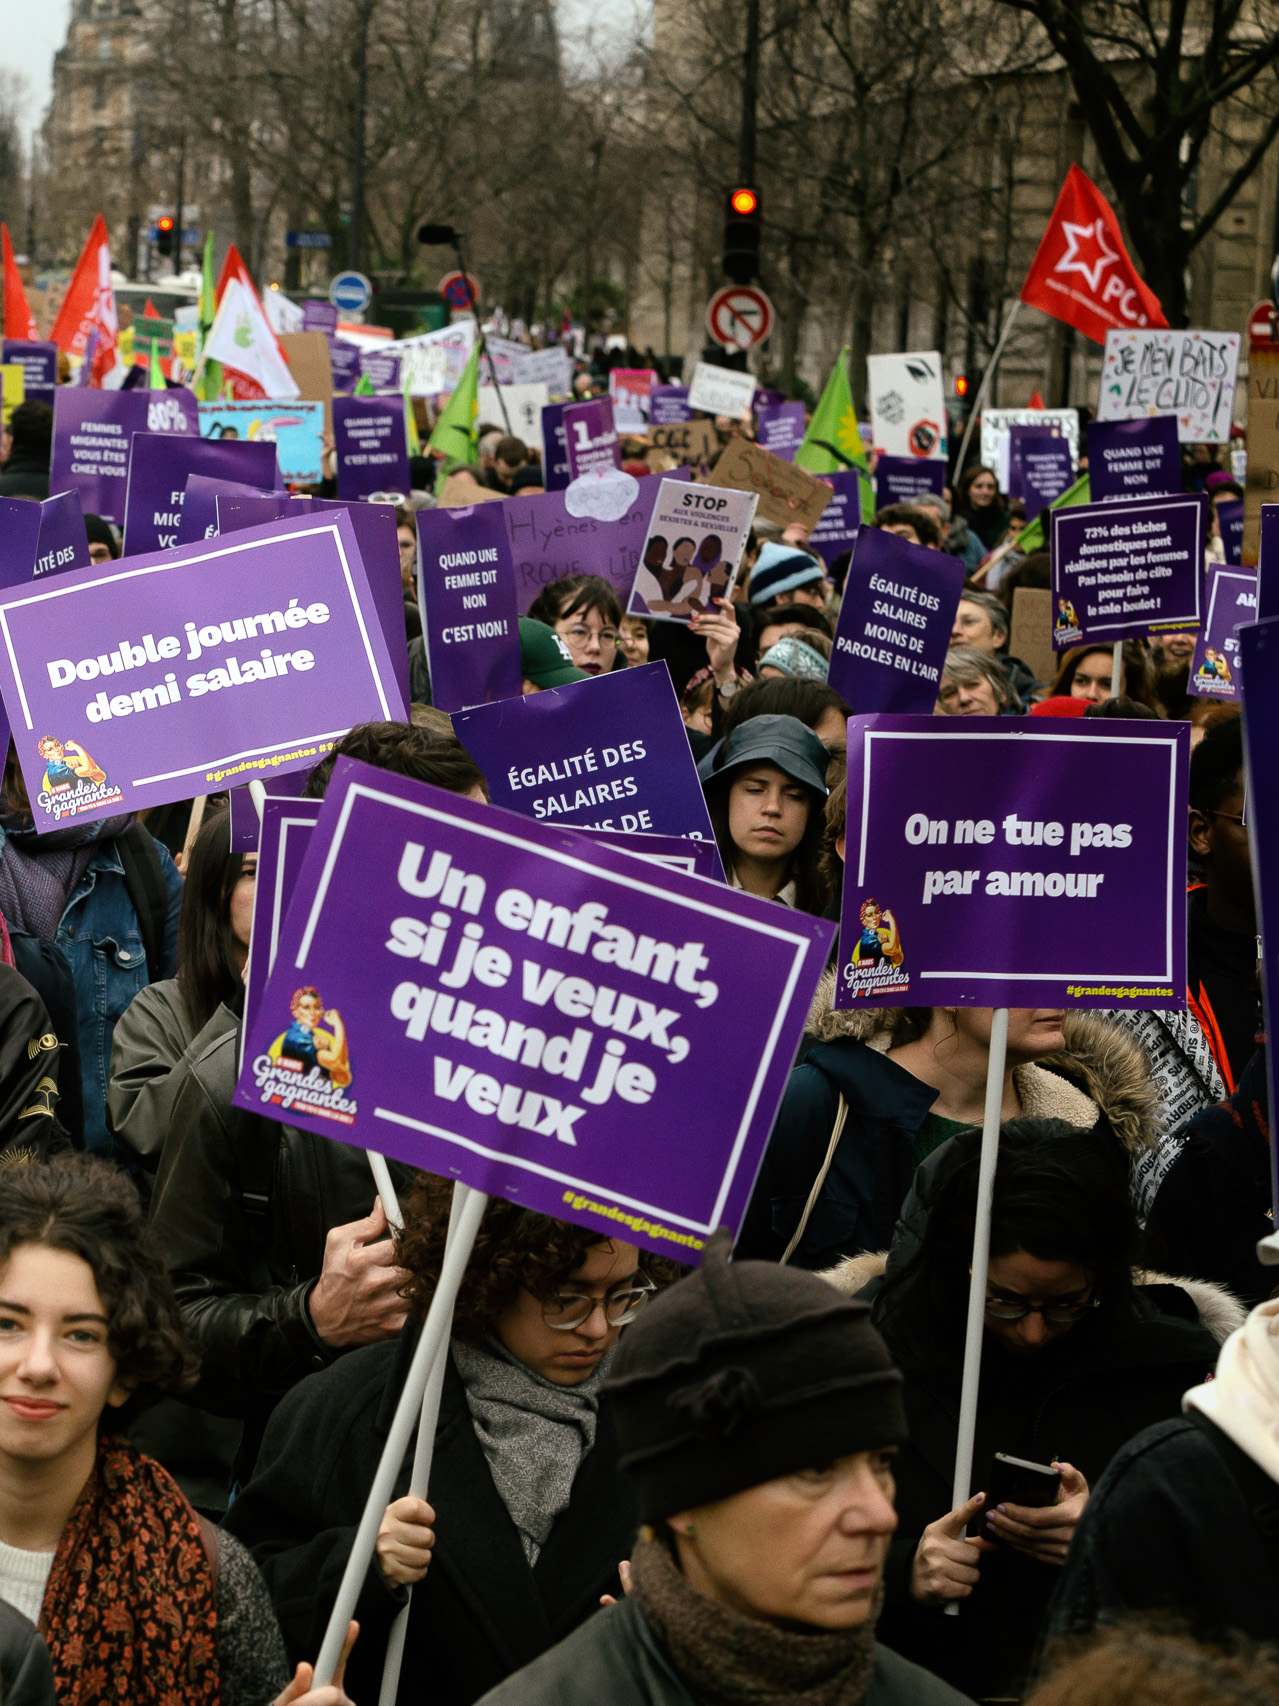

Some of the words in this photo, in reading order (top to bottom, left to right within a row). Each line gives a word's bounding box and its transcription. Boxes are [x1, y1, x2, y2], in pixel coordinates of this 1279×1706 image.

[1114, 345, 1137, 377] JE
[1179, 338, 1228, 379] BATS
[1125, 374, 1151, 408] LE
[81, 422, 123, 436] FEMMES
[148, 400, 187, 431] 80%
[70, 435, 129, 450] MIGRANTES
[73, 449, 102, 462] VOUS
[1103, 447, 1143, 461] QUAND
[1142, 444, 1165, 456] UNE
[70, 463, 98, 475] CHEZ
[98, 465, 127, 478] VOUS
[1107, 460, 1145, 473] FEMME
[1123, 473, 1149, 485] NON
[682, 493, 728, 512] STOP
[689, 509, 730, 523] VIOLENCES
[509, 509, 598, 552] Hyènes
[1084, 525, 1109, 539] 73%
[1110, 523, 1131, 536] des
[1131, 520, 1167, 535] tâches
[56, 545, 75, 566] DES
[439, 551, 477, 571] QUAND
[477, 547, 499, 564] UNE
[1079, 540, 1148, 556] domestiques
[1149, 535, 1172, 548] sont
[1065, 556, 1108, 574] réalisées
[1108, 556, 1130, 570] par
[1130, 553, 1146, 566] les
[1146, 550, 1189, 564] femmes
[444, 573, 480, 590] FEMME
[481, 570, 497, 585] DIT
[868, 573, 919, 603] ÉGALITÉ
[918, 593, 940, 612] DES
[1077, 574, 1097, 588] Pas
[1097, 570, 1135, 585] besoin
[1135, 569, 1149, 581] de
[1098, 588, 1126, 602] pour
[1126, 584, 1150, 597] faire
[462, 593, 487, 610] NON
[872, 600, 928, 630] SALAIRES
[1087, 605, 1098, 616] le
[1098, 602, 1122, 616] sale
[1122, 597, 1157, 613] boulot
[46, 632, 182, 689] Double
[184, 598, 331, 662] journée
[442, 622, 474, 645] C'EST
[476, 621, 503, 640] NON
[864, 623, 907, 648] MOINS
[906, 635, 925, 654] DE
[836, 636, 893, 664] PAROLES
[892, 655, 919, 672] EN
[918, 660, 939, 683] L'AIR
[85, 673, 182, 724] demi
[186, 645, 316, 698] salaire
[205, 744, 317, 784] #grandesgagnantes
[508, 747, 599, 791] ÉGALITÉ
[601, 740, 647, 769] DES
[37, 779, 98, 813] Grandes
[52, 783, 122, 820] gagnantes
[532, 776, 639, 819] SALAIRES
[620, 810, 653, 834] DE
[904, 813, 948, 846] On
[953, 819, 996, 846] ne
[1002, 814, 1065, 847] tue
[1069, 821, 1133, 856] pas
[922, 869, 981, 905] par
[985, 870, 1104, 899] amour
[397, 840, 487, 916] Un
[495, 886, 720, 1009] enfant,
[385, 913, 454, 967] si
[439, 920, 513, 991] je
[522, 959, 691, 1064] veux,
[843, 957, 894, 989] Grandes
[852, 966, 911, 999] gagnantes
[1066, 984, 1174, 999] #grandesgagnantes
[390, 979, 595, 1082] quand
[580, 1040, 658, 1104] je
[253, 1054, 333, 1095] Grandes
[260, 1079, 358, 1115] gagnantes
[433, 1054, 588, 1147] veux
